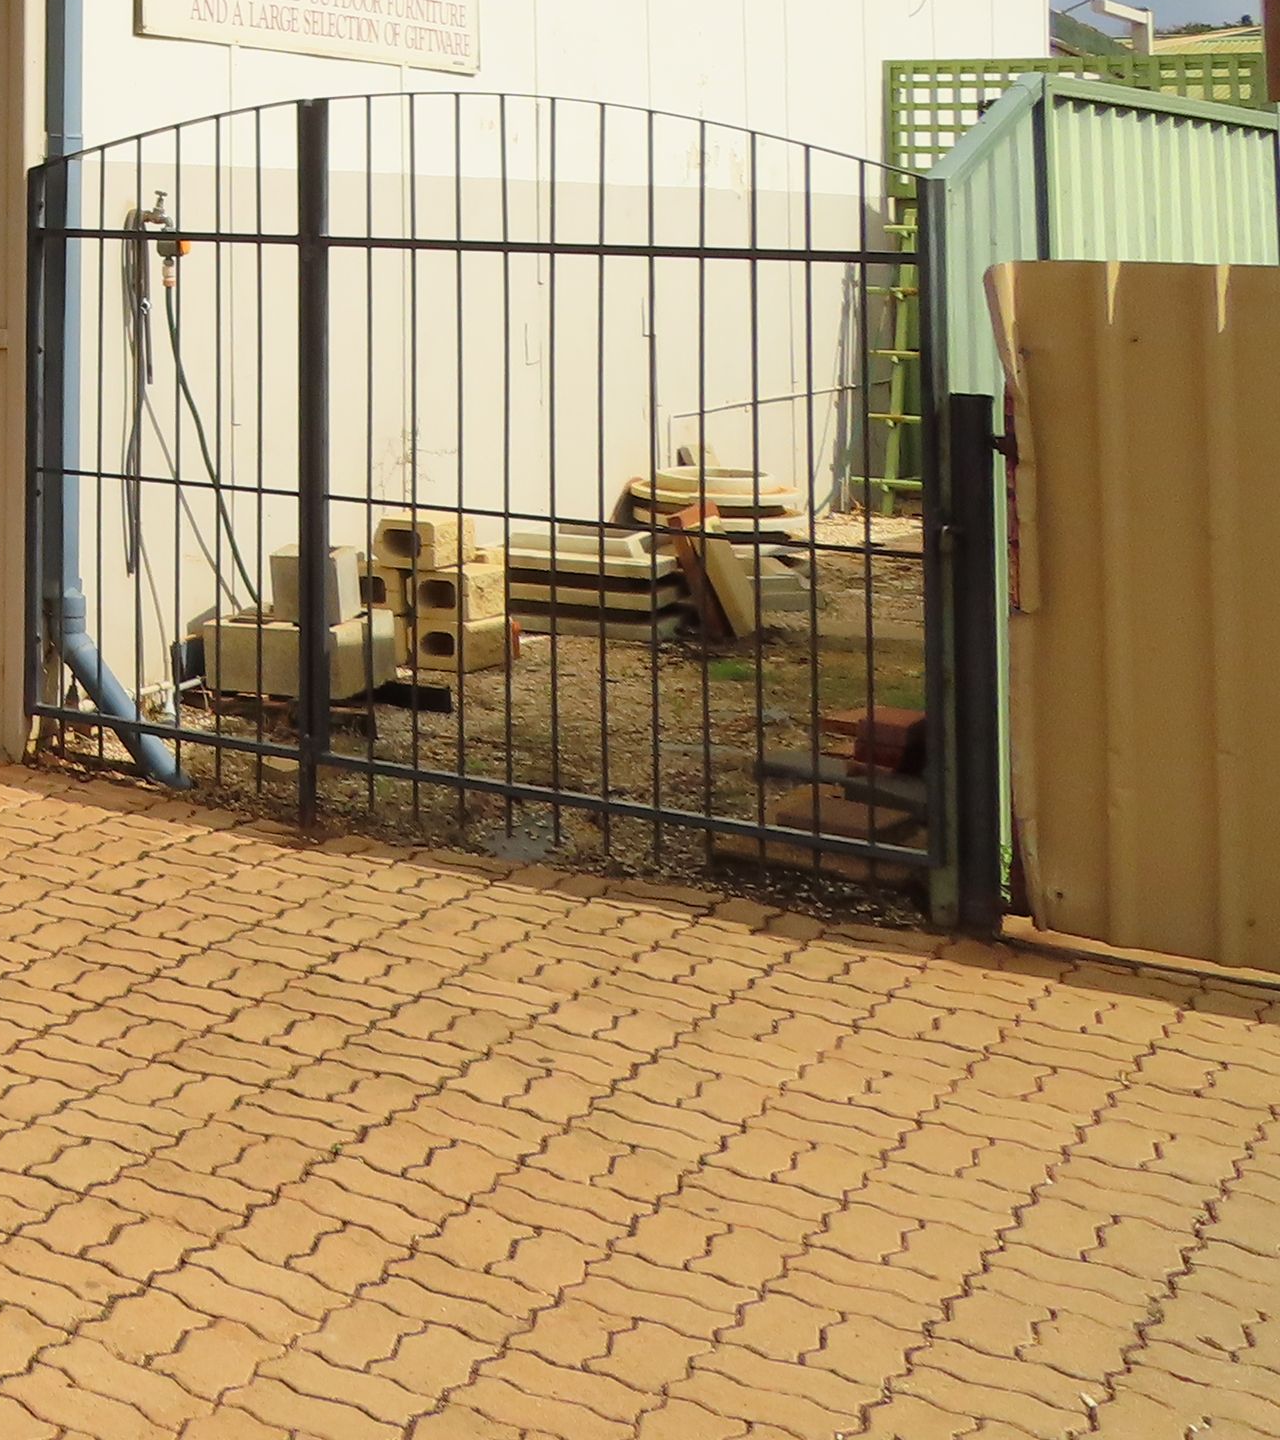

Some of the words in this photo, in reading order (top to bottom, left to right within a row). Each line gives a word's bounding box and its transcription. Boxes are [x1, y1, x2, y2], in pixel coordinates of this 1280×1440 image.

[232, 0, 244, 27] A
[248, 1, 301, 34] LARGE
[303, 8, 380, 44] SELECTION
[384, 21, 401, 47] OF
[404, 24, 472, 58] GIFTWARE
